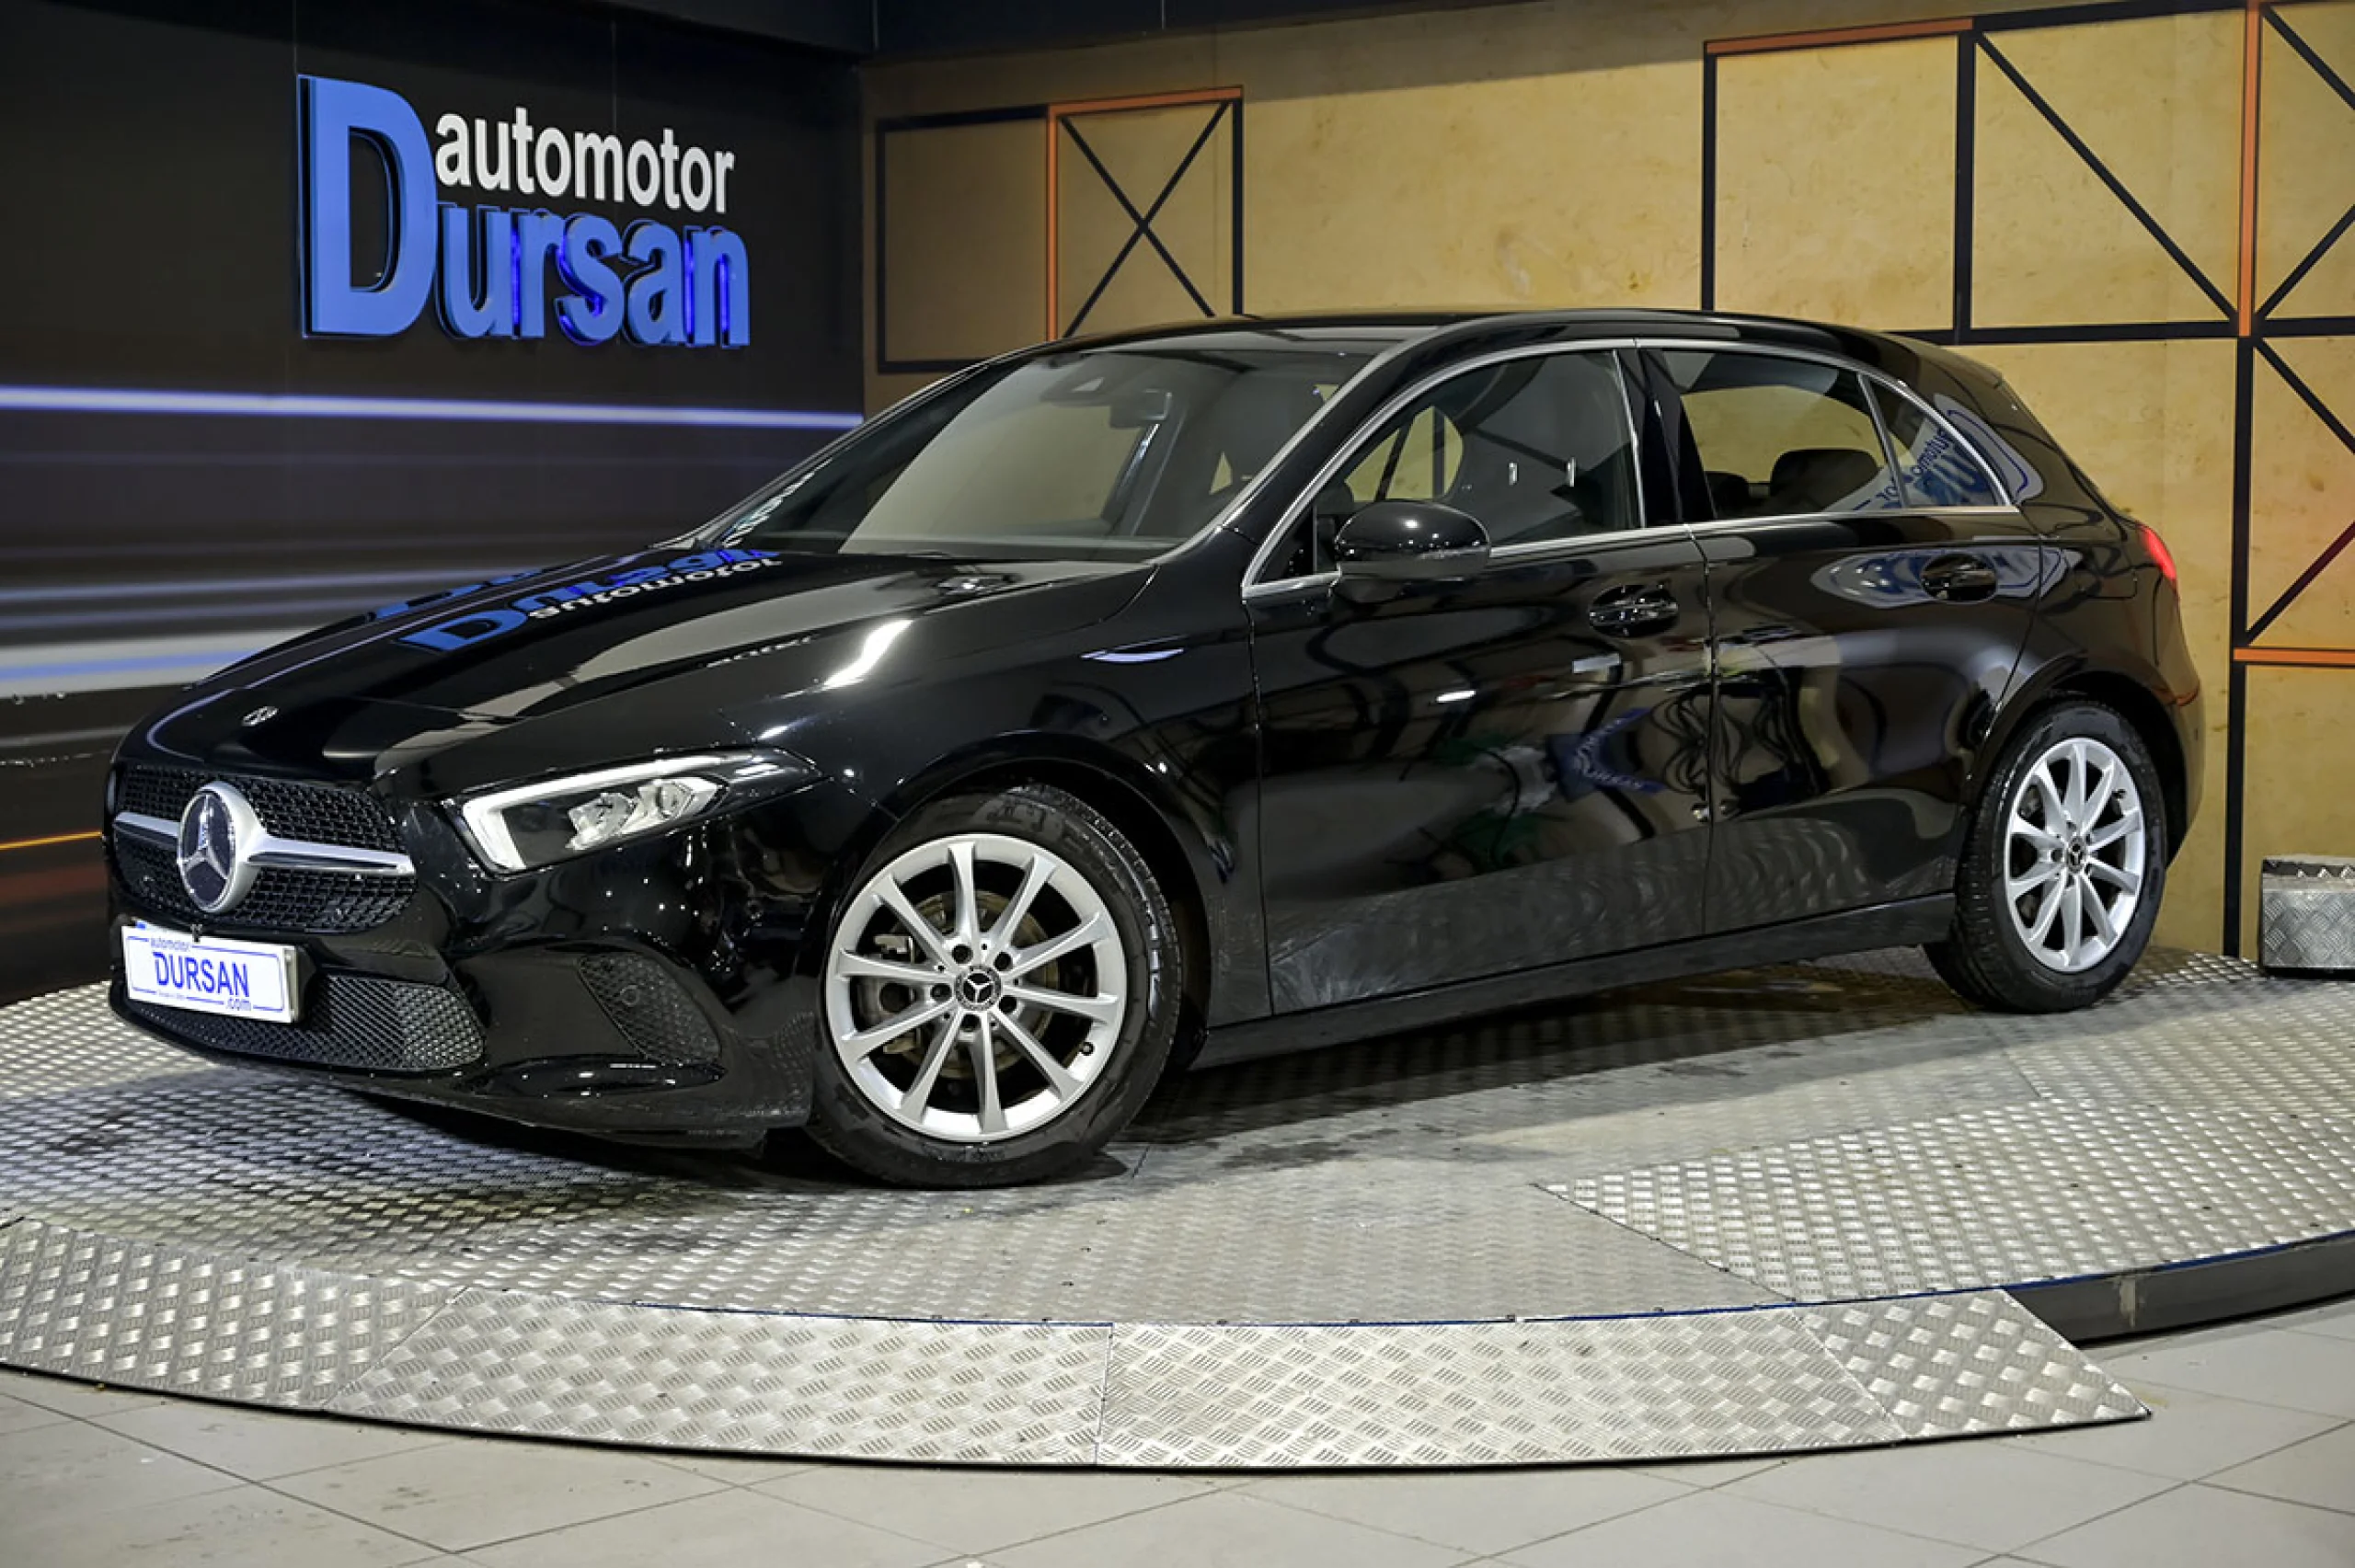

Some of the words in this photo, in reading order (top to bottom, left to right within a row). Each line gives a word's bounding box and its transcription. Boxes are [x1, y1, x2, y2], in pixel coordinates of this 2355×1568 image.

[296, 74, 750, 348] Dursan
[435, 107, 735, 213] automotor
[153, 951, 249, 998] DURSAN
